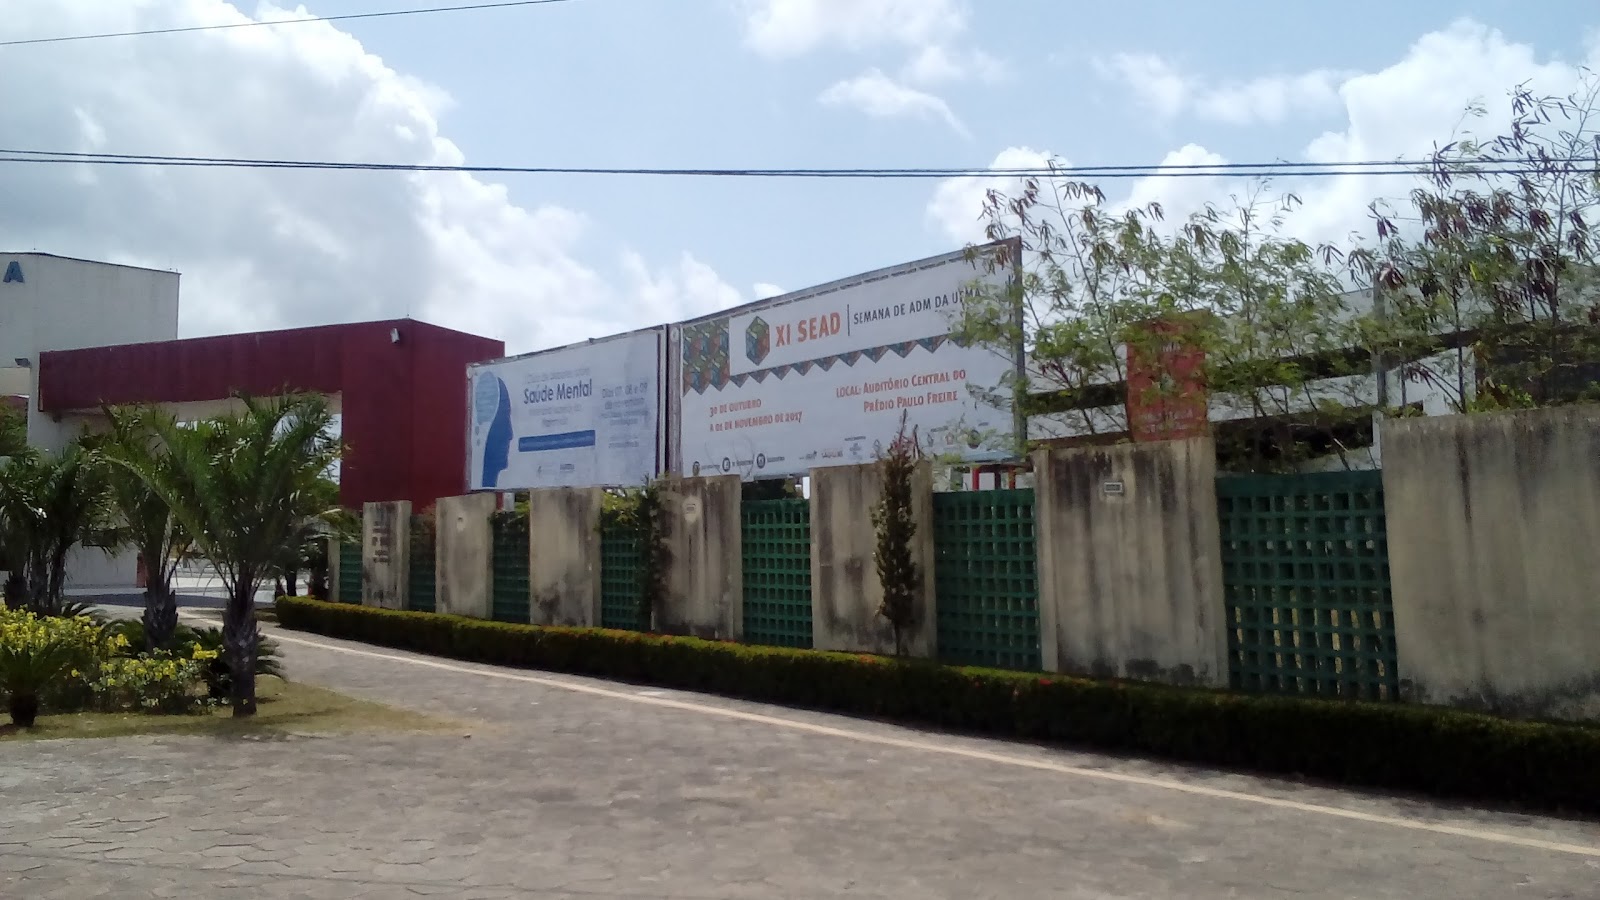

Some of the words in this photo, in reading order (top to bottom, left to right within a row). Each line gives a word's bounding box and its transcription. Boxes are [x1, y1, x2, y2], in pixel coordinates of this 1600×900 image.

[3, 261, 25, 283] A
[854, 307, 891, 325] SEMANA
[894, 303, 905, 316] DE
[910, 298, 931, 313] ADM
[935, 295, 949, 308] DA
[776, 324, 791, 347] XI
[798, 312, 841, 342] SEAD
[523, 384, 554, 404] Saúde
[557, 378, 592, 400] Mental
[864, 377, 909, 394] AUDITÓRIO
[911, 372, 950, 387] CENTRAL
[953, 369, 966, 380] DO
[729, 398, 762, 412] OUTUBRO
[864, 398, 894, 412] PRÉDIO
[896, 395, 924, 409] PAULO
[927, 391, 958, 404] FREIRE
[734, 414, 773, 429] NOVEMBRO
[785, 411, 803, 423] 2017
